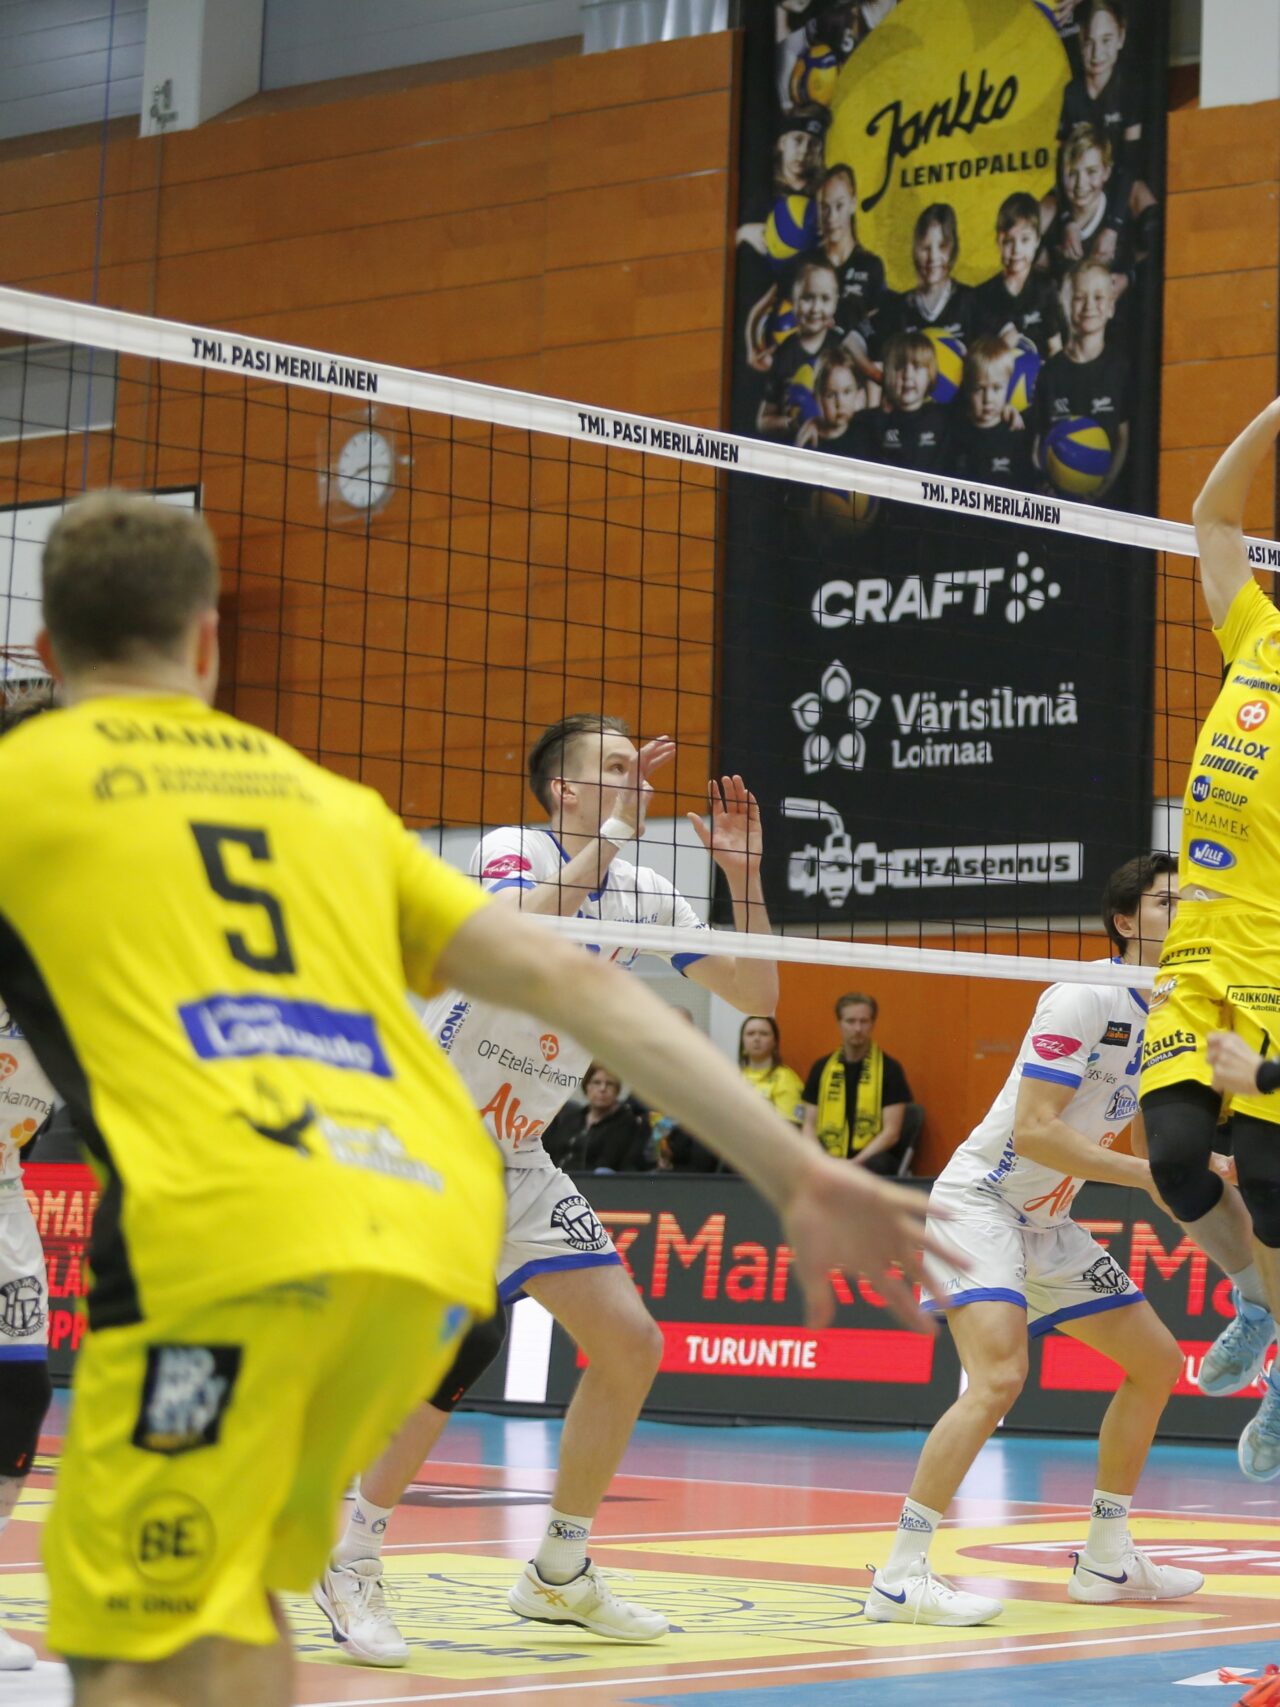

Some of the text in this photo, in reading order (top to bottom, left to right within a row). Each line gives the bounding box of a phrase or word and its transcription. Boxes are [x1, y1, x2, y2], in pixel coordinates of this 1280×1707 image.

[900, 147, 1049, 188] LENTOPALLO
[191, 337, 379, 393] TMI. PASI MERILÄINEN
[578, 412, 739, 464] TMI. PASI MERILÄINEN
[921, 481, 1061, 525] TMI. PASI MERILÄINEN
[1244, 546, 1266, 564] ASI
[811, 568, 1003, 628] CRAFT
[891, 682, 1079, 735] Värisilmä
[891, 739, 993, 769] Loimaa
[1211, 732, 1270, 760] VALLOX
[1211, 787, 1249, 807] GROUP
[903, 850, 1071, 880] HT-Asennus
[189, 821, 298, 975] 5
[478, 1039, 499, 1060] OP
[686, 1335, 817, 1369] TURUNTIE
